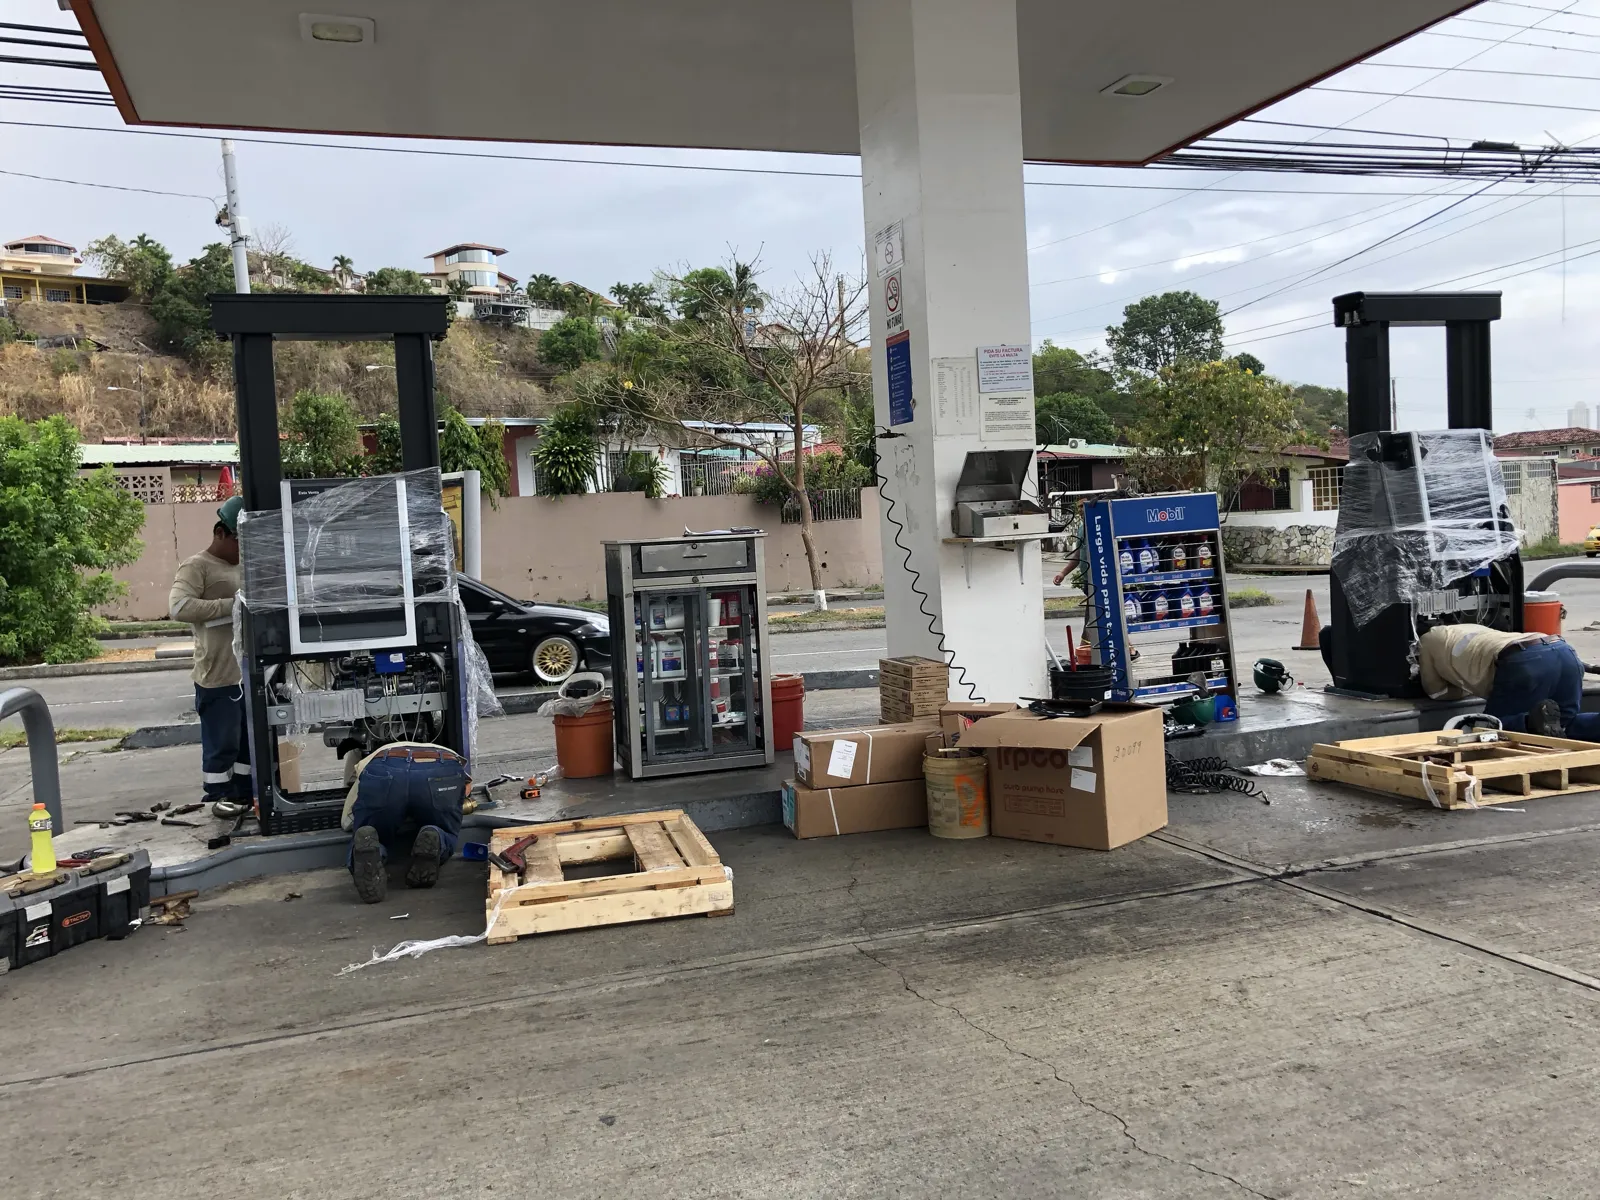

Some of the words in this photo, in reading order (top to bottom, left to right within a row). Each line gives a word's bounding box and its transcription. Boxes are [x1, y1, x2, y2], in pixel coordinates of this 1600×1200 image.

[1146, 507, 1185, 523] Mobil
[1094, 515, 1104, 554] Larga
[1099, 556, 1109, 586] vida
[1101, 589, 1111, 619] para
[1021, 784, 1044, 795] pump
[1045, 784, 1065, 795] hose
